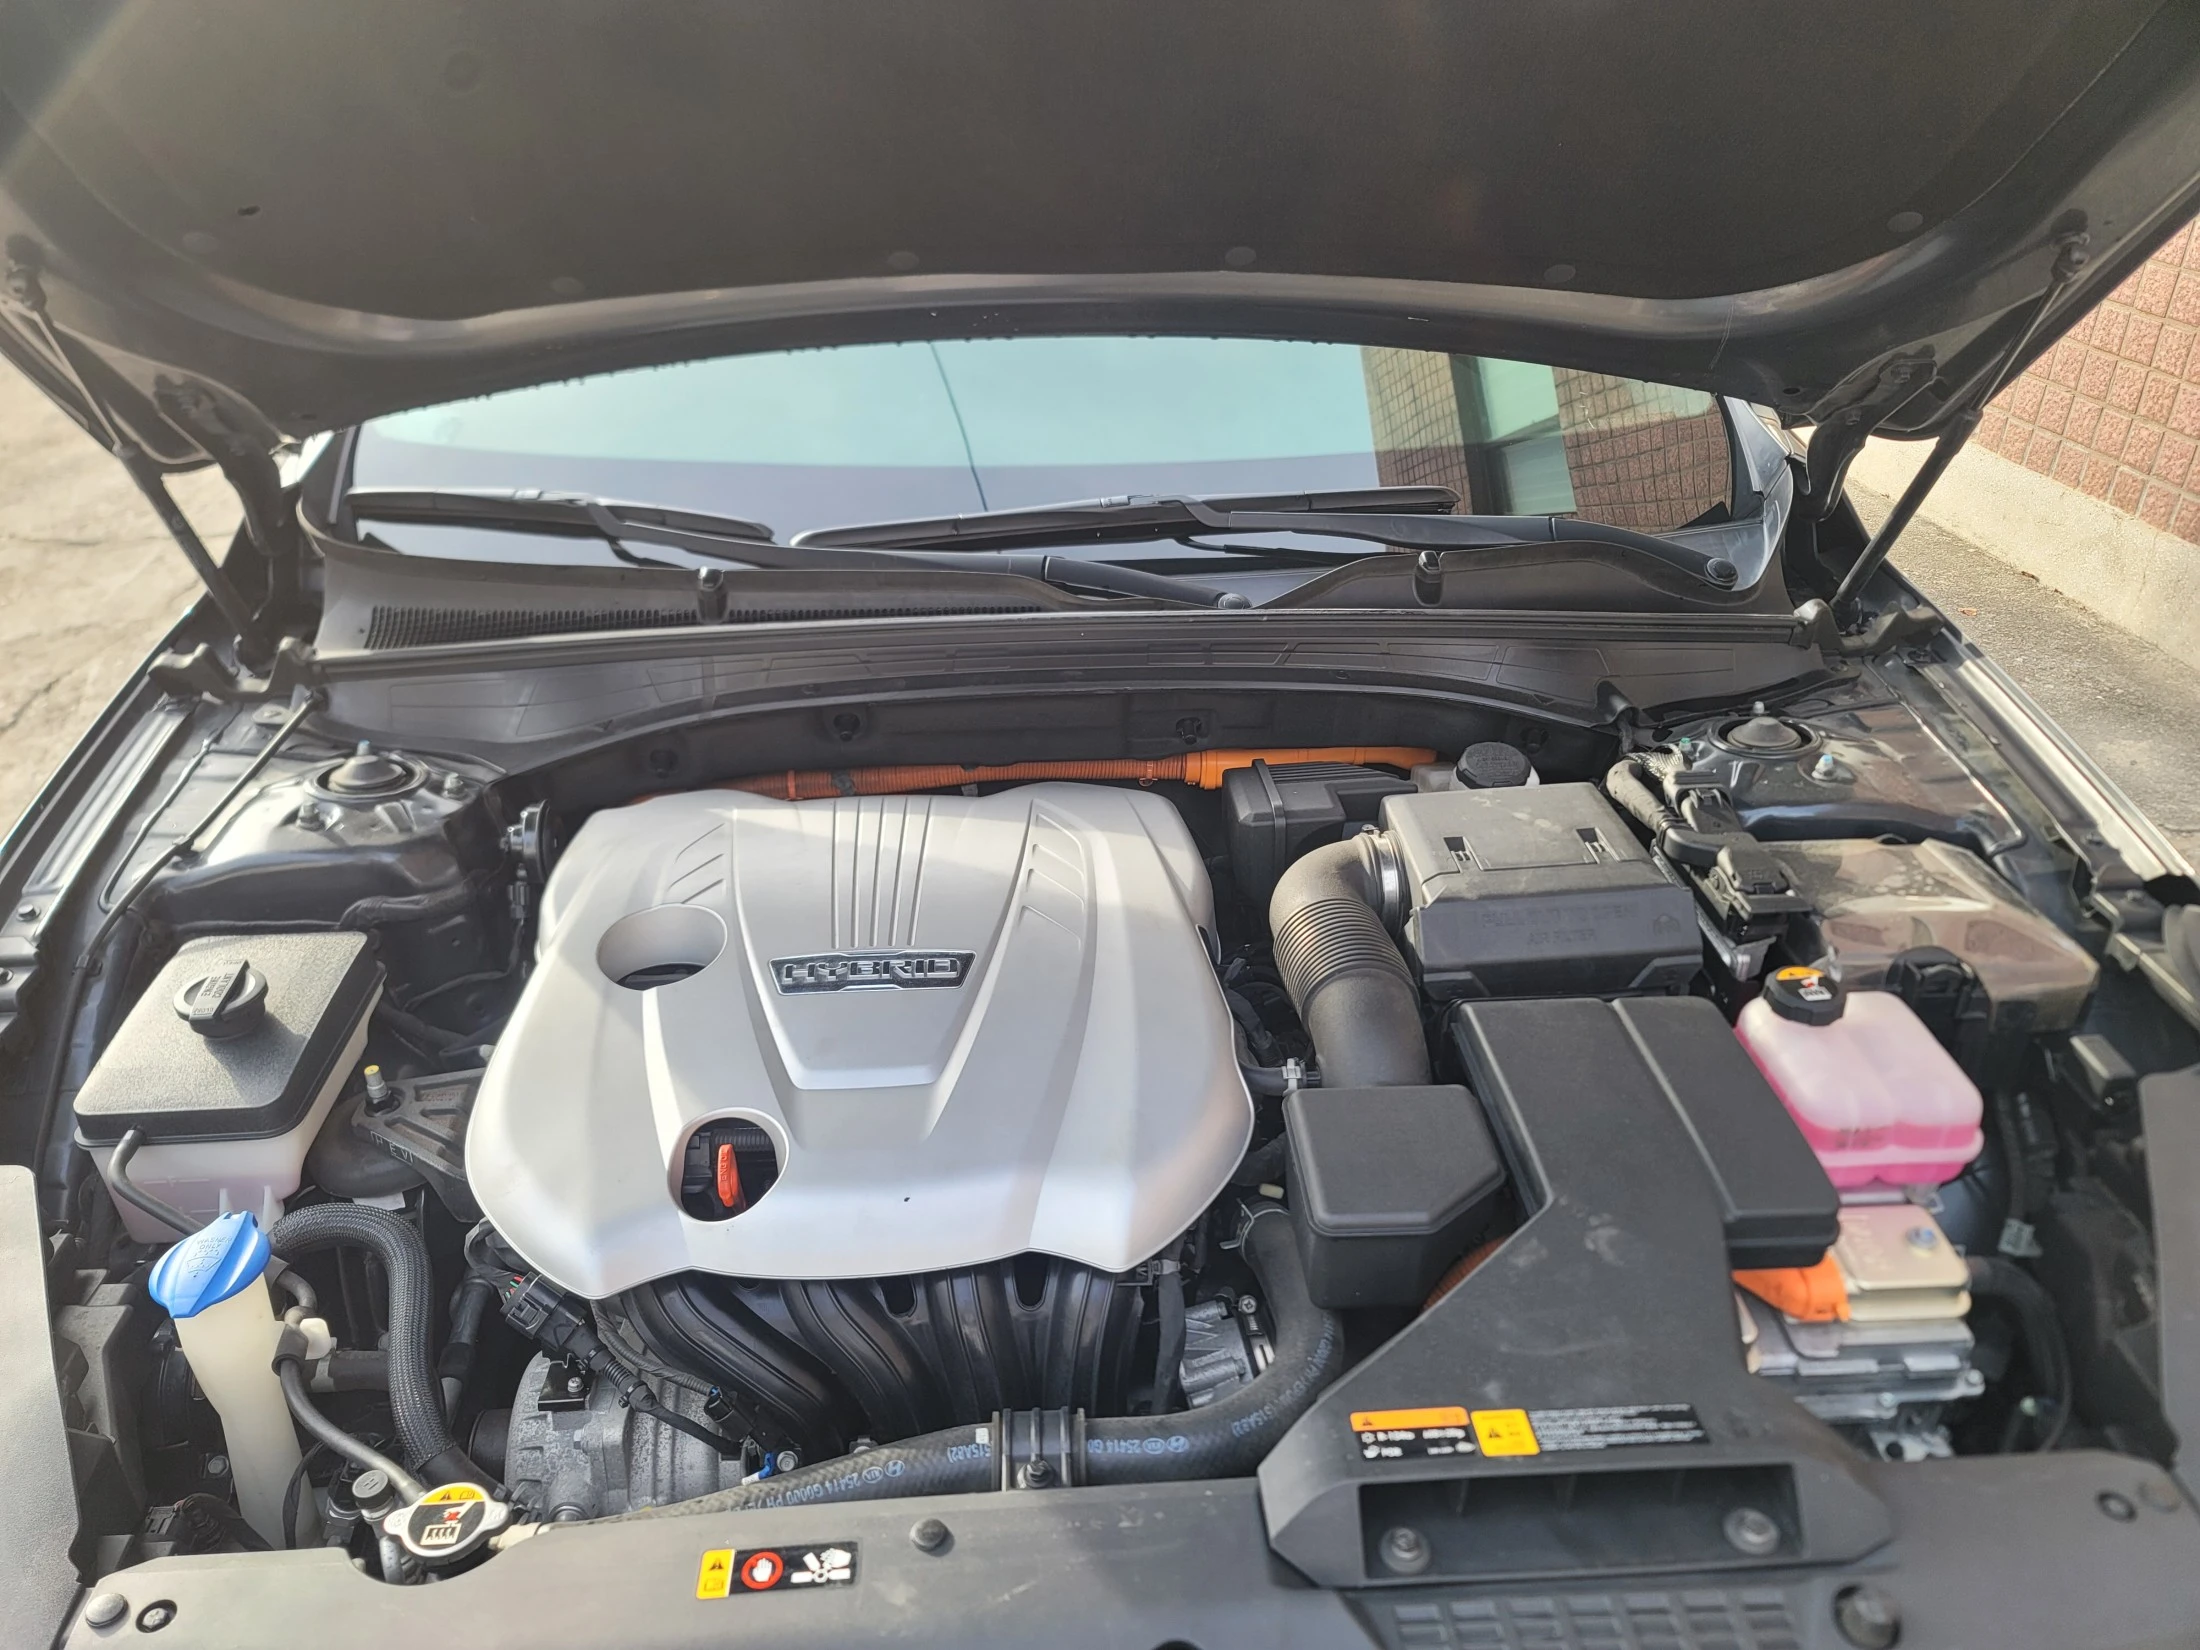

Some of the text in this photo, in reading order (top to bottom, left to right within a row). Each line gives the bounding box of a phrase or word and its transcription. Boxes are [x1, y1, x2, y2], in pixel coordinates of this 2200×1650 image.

[782, 957, 960, 984] HYBRID
[947, 1443, 991, 1464] 515A82)
[1088, 1438, 1103, 1454] G0
[1106, 1438, 1141, 1454] 25414
[786, 1482, 824, 1505] G0000
[825, 1472, 860, 1495] 25414
